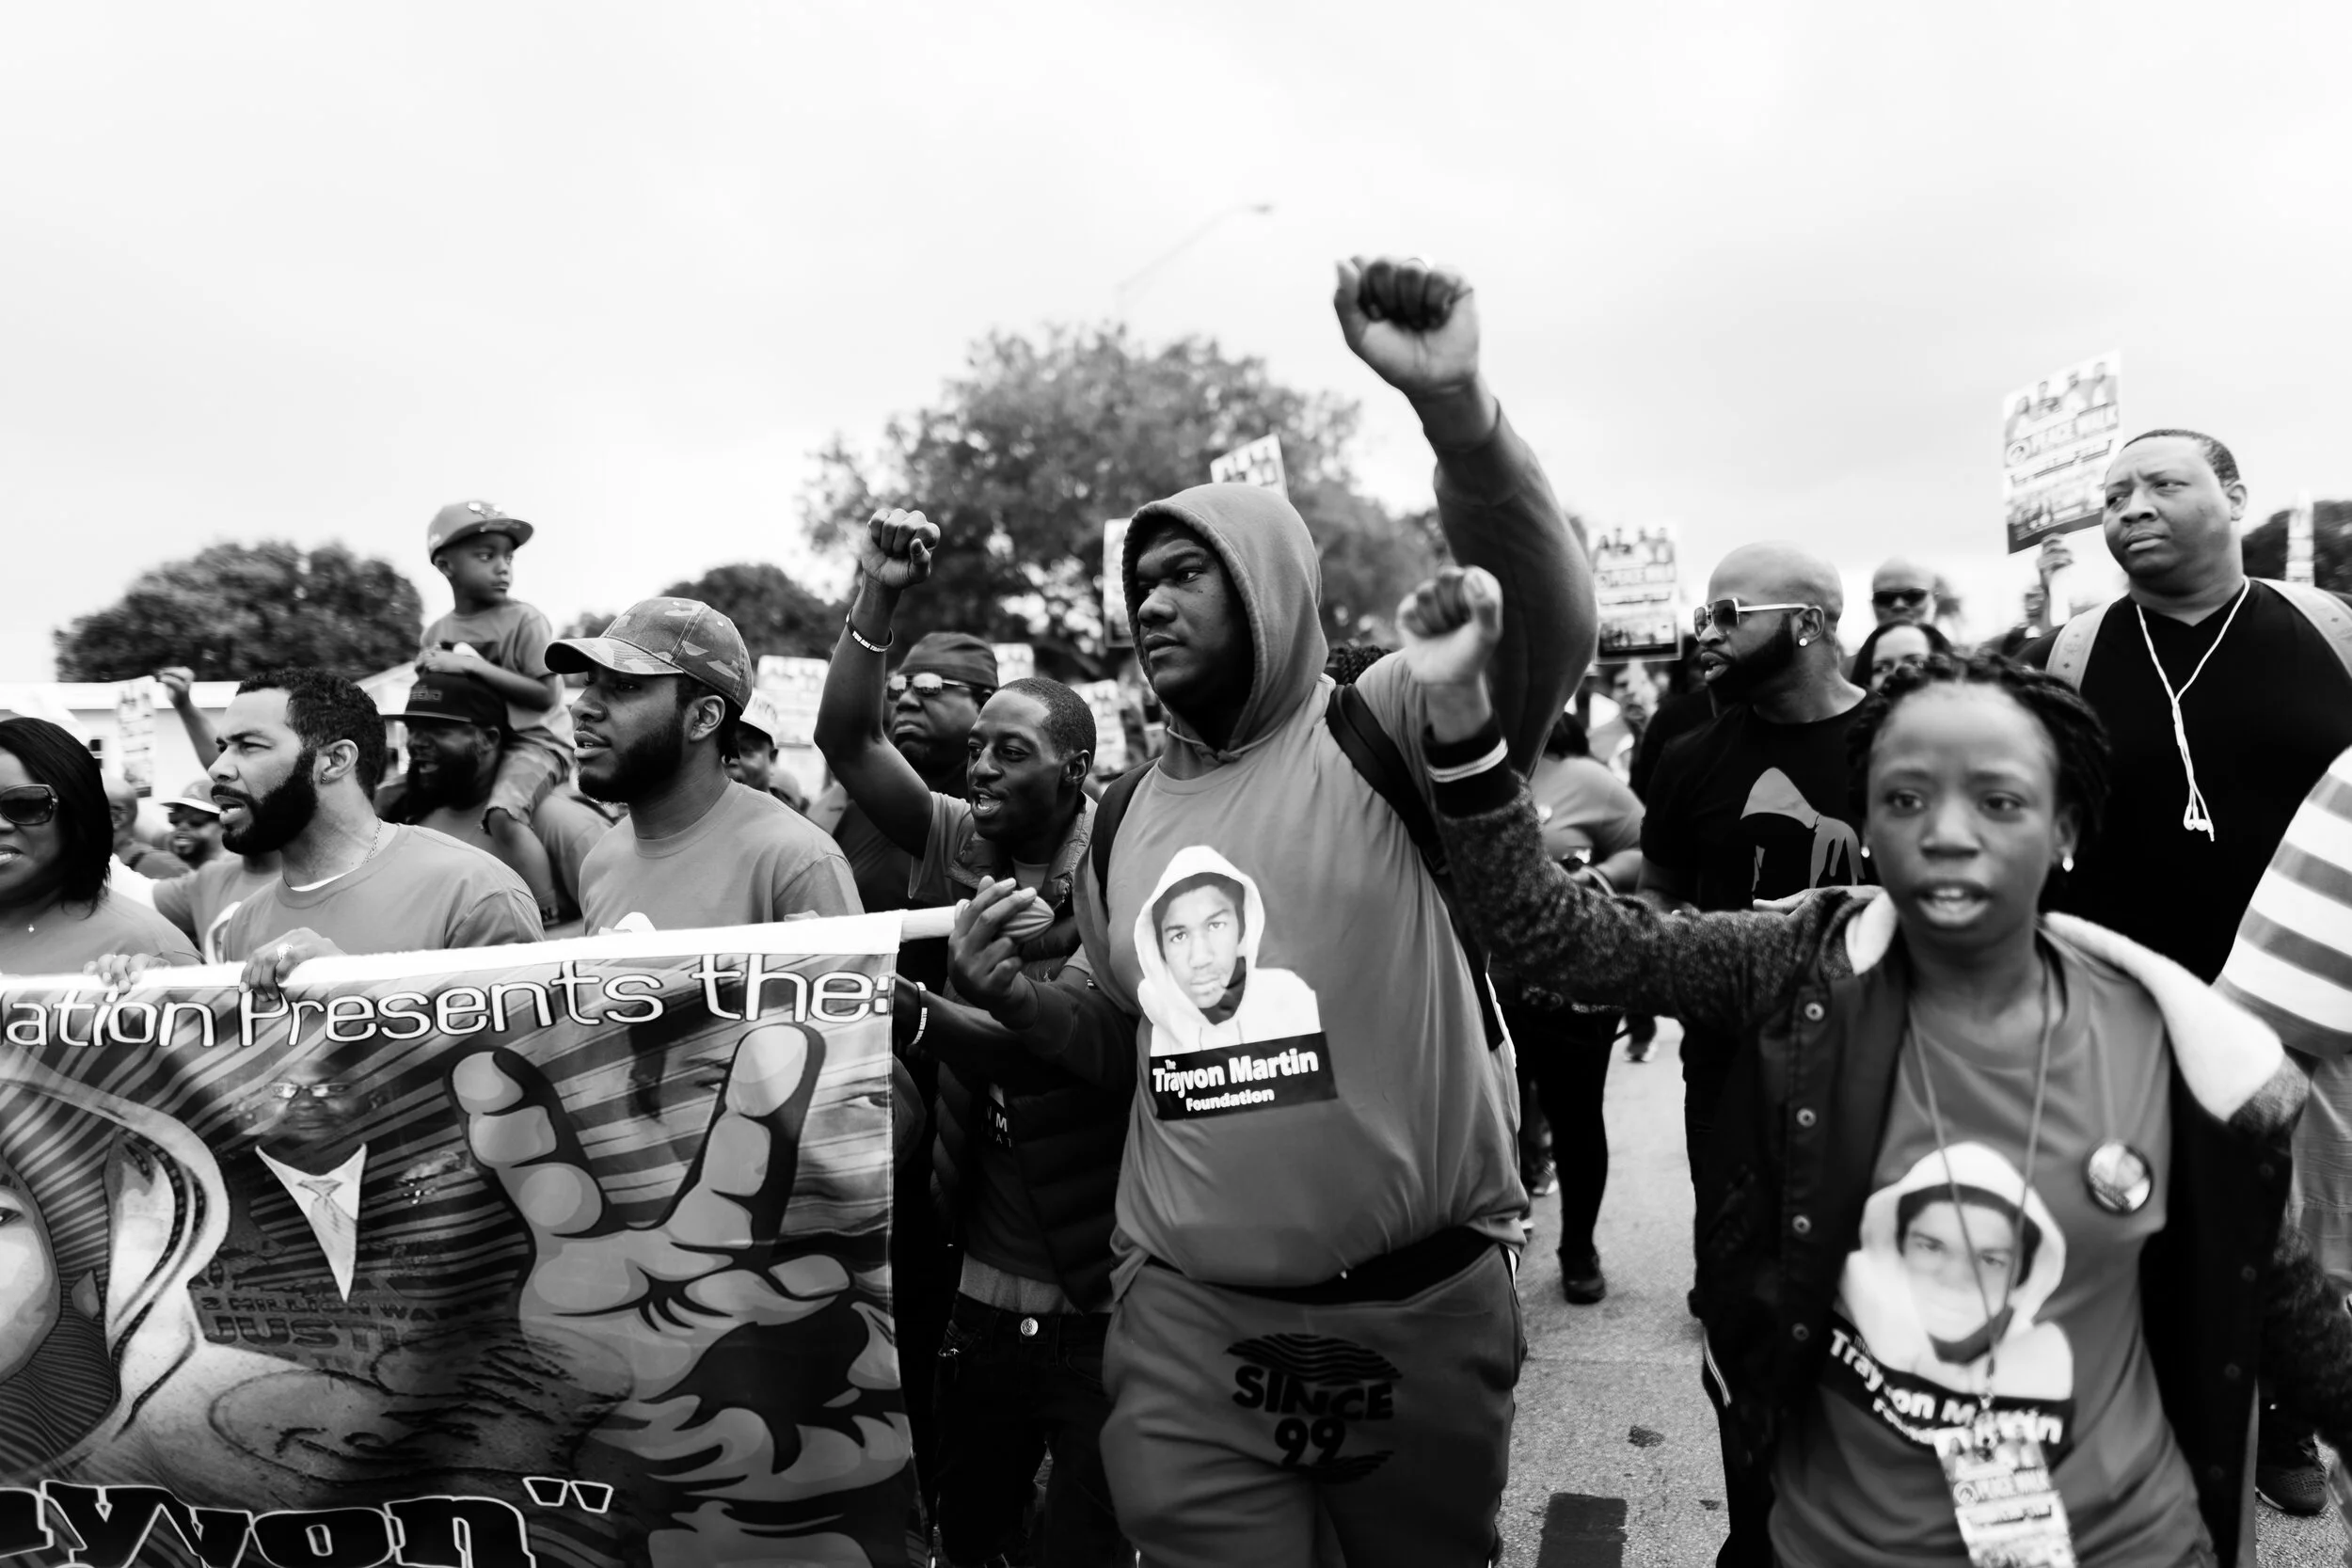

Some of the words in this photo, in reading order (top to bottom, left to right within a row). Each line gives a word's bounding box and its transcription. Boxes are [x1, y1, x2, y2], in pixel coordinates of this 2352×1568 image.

[241, 960, 664, 1047] Presents
[690, 954, 889, 1023] the:
[1152, 1065, 1226, 1099] Trayvon
[1229, 1048, 1319, 1084] Martin
[1165, 1059, 1177, 1071] The
[1185, 1087, 1276, 1112] Foundation
[229, 1297, 371, 1315] MILLION
[1232, 1365, 1394, 1421] SINCE
[1274, 1417, 1346, 1467] 99
[0, 1477, 614, 1568] yvon"
